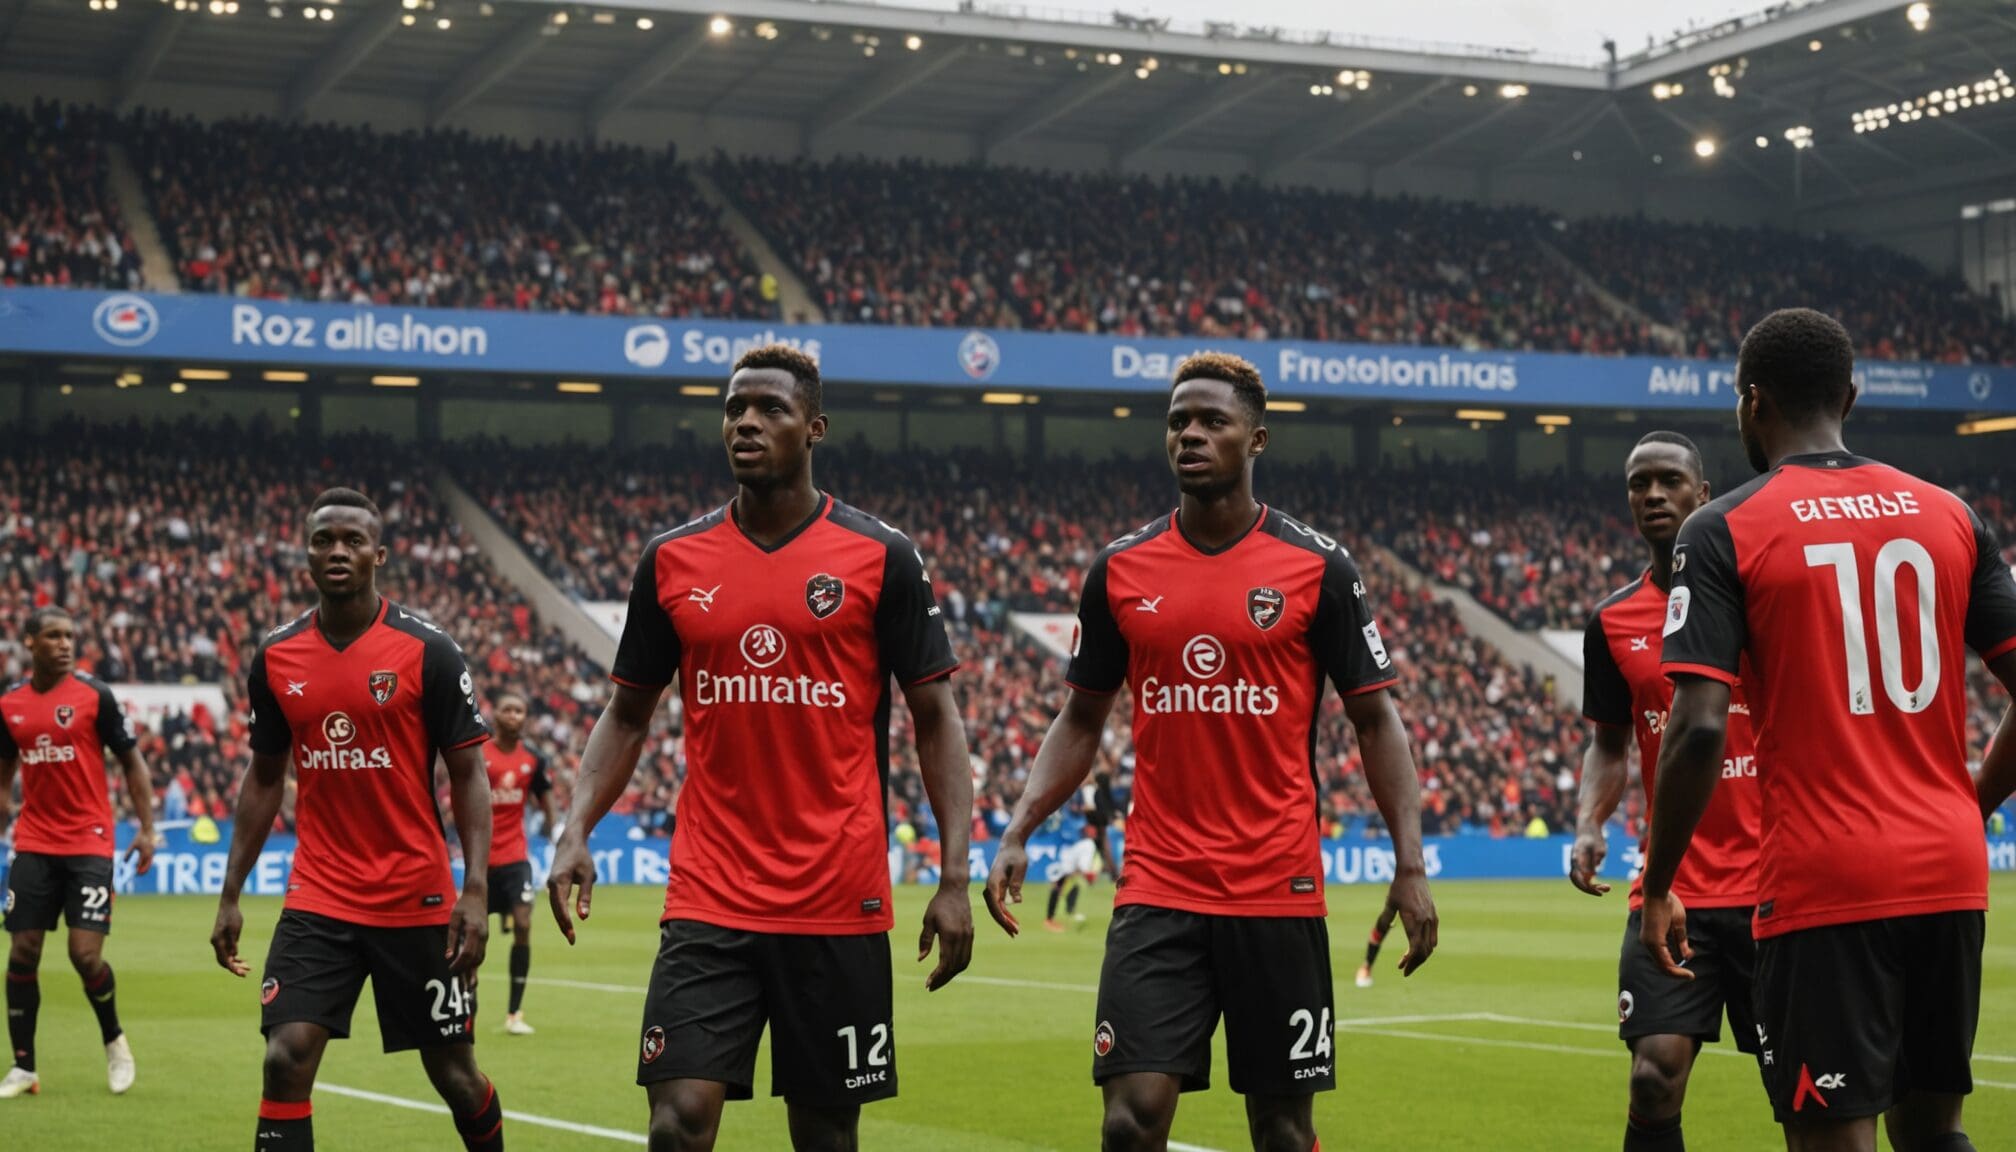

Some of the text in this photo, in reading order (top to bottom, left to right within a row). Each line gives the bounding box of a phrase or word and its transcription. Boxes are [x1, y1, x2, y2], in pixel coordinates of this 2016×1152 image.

[232, 304, 316, 346] Roz
[1804, 538, 1941, 714] 10
[837, 1023, 888, 1069] 12
